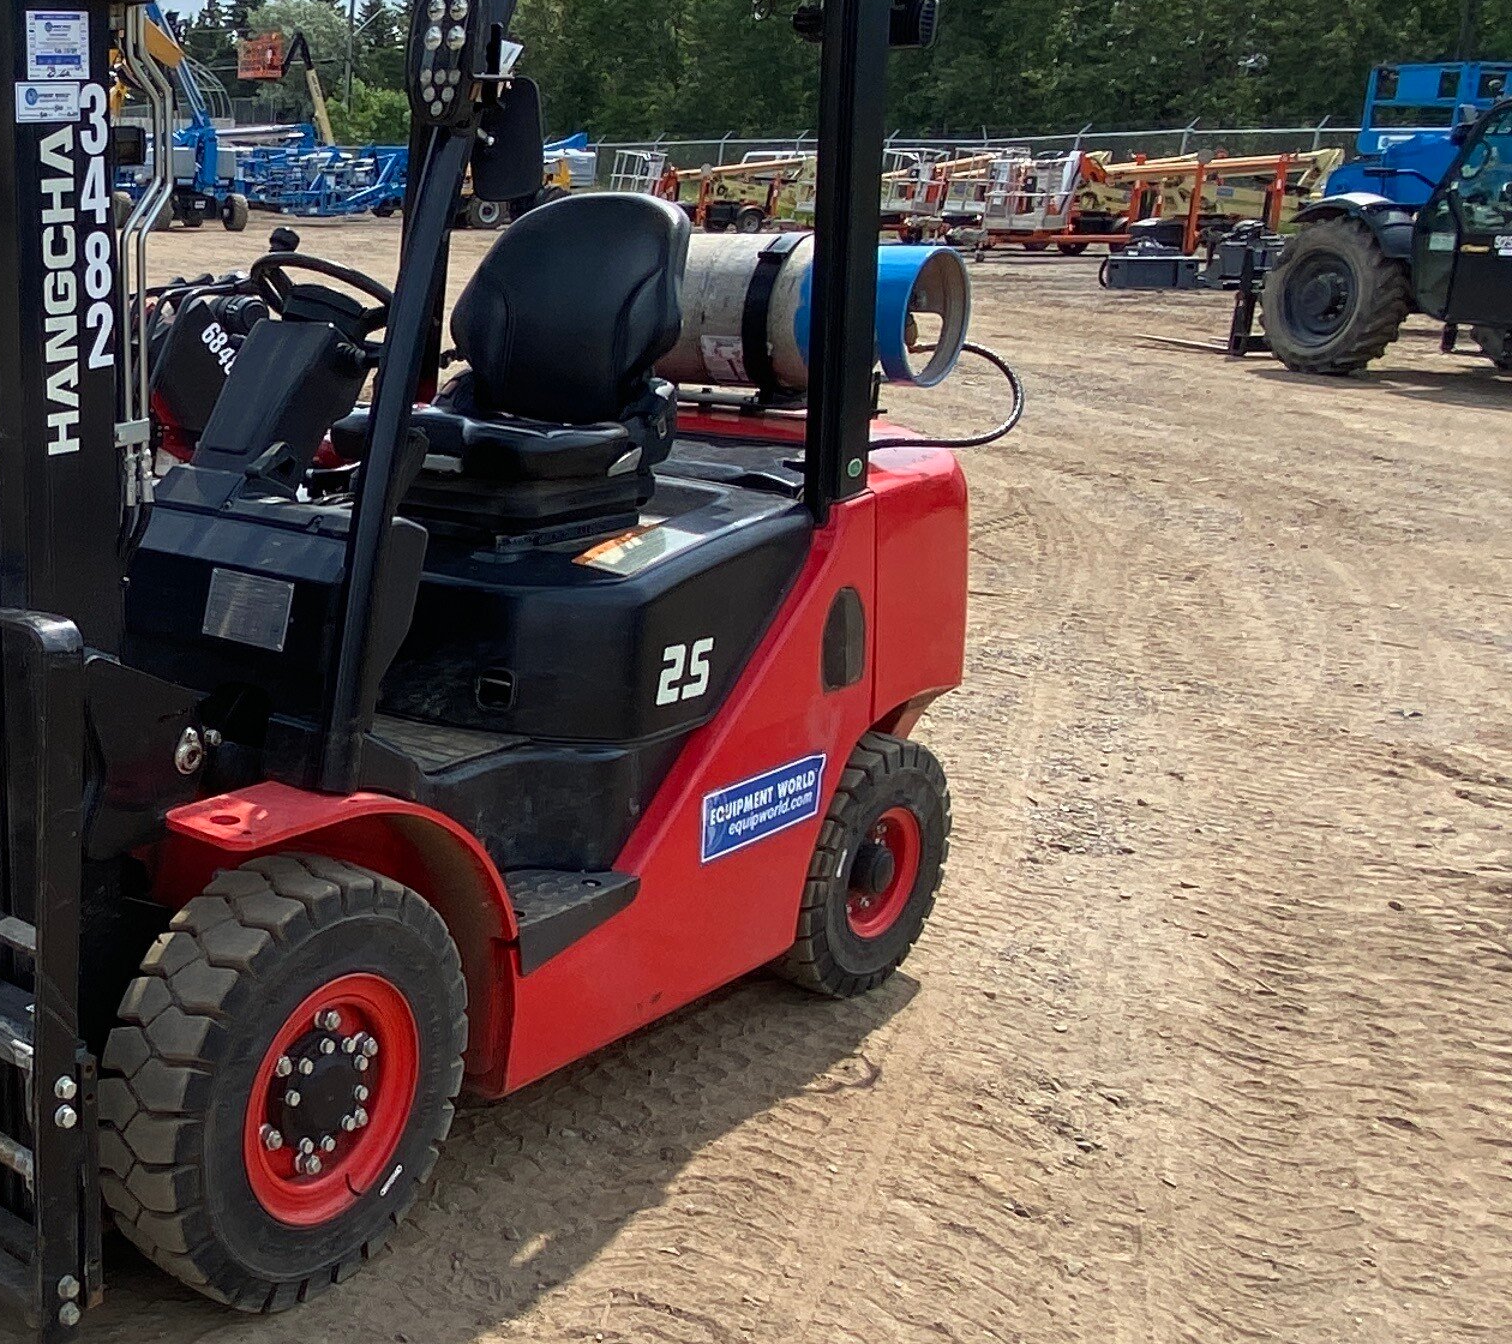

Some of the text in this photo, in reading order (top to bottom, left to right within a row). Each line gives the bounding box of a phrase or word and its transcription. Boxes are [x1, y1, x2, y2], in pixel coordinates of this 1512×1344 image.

[78, 82, 115, 370] 3482
[39, 124, 80, 456] HANGCHA
[656, 637, 714, 706] 25
[709, 769, 816, 826] EQUIPMENT WORLD
[728, 791, 813, 836] equipworld.com
